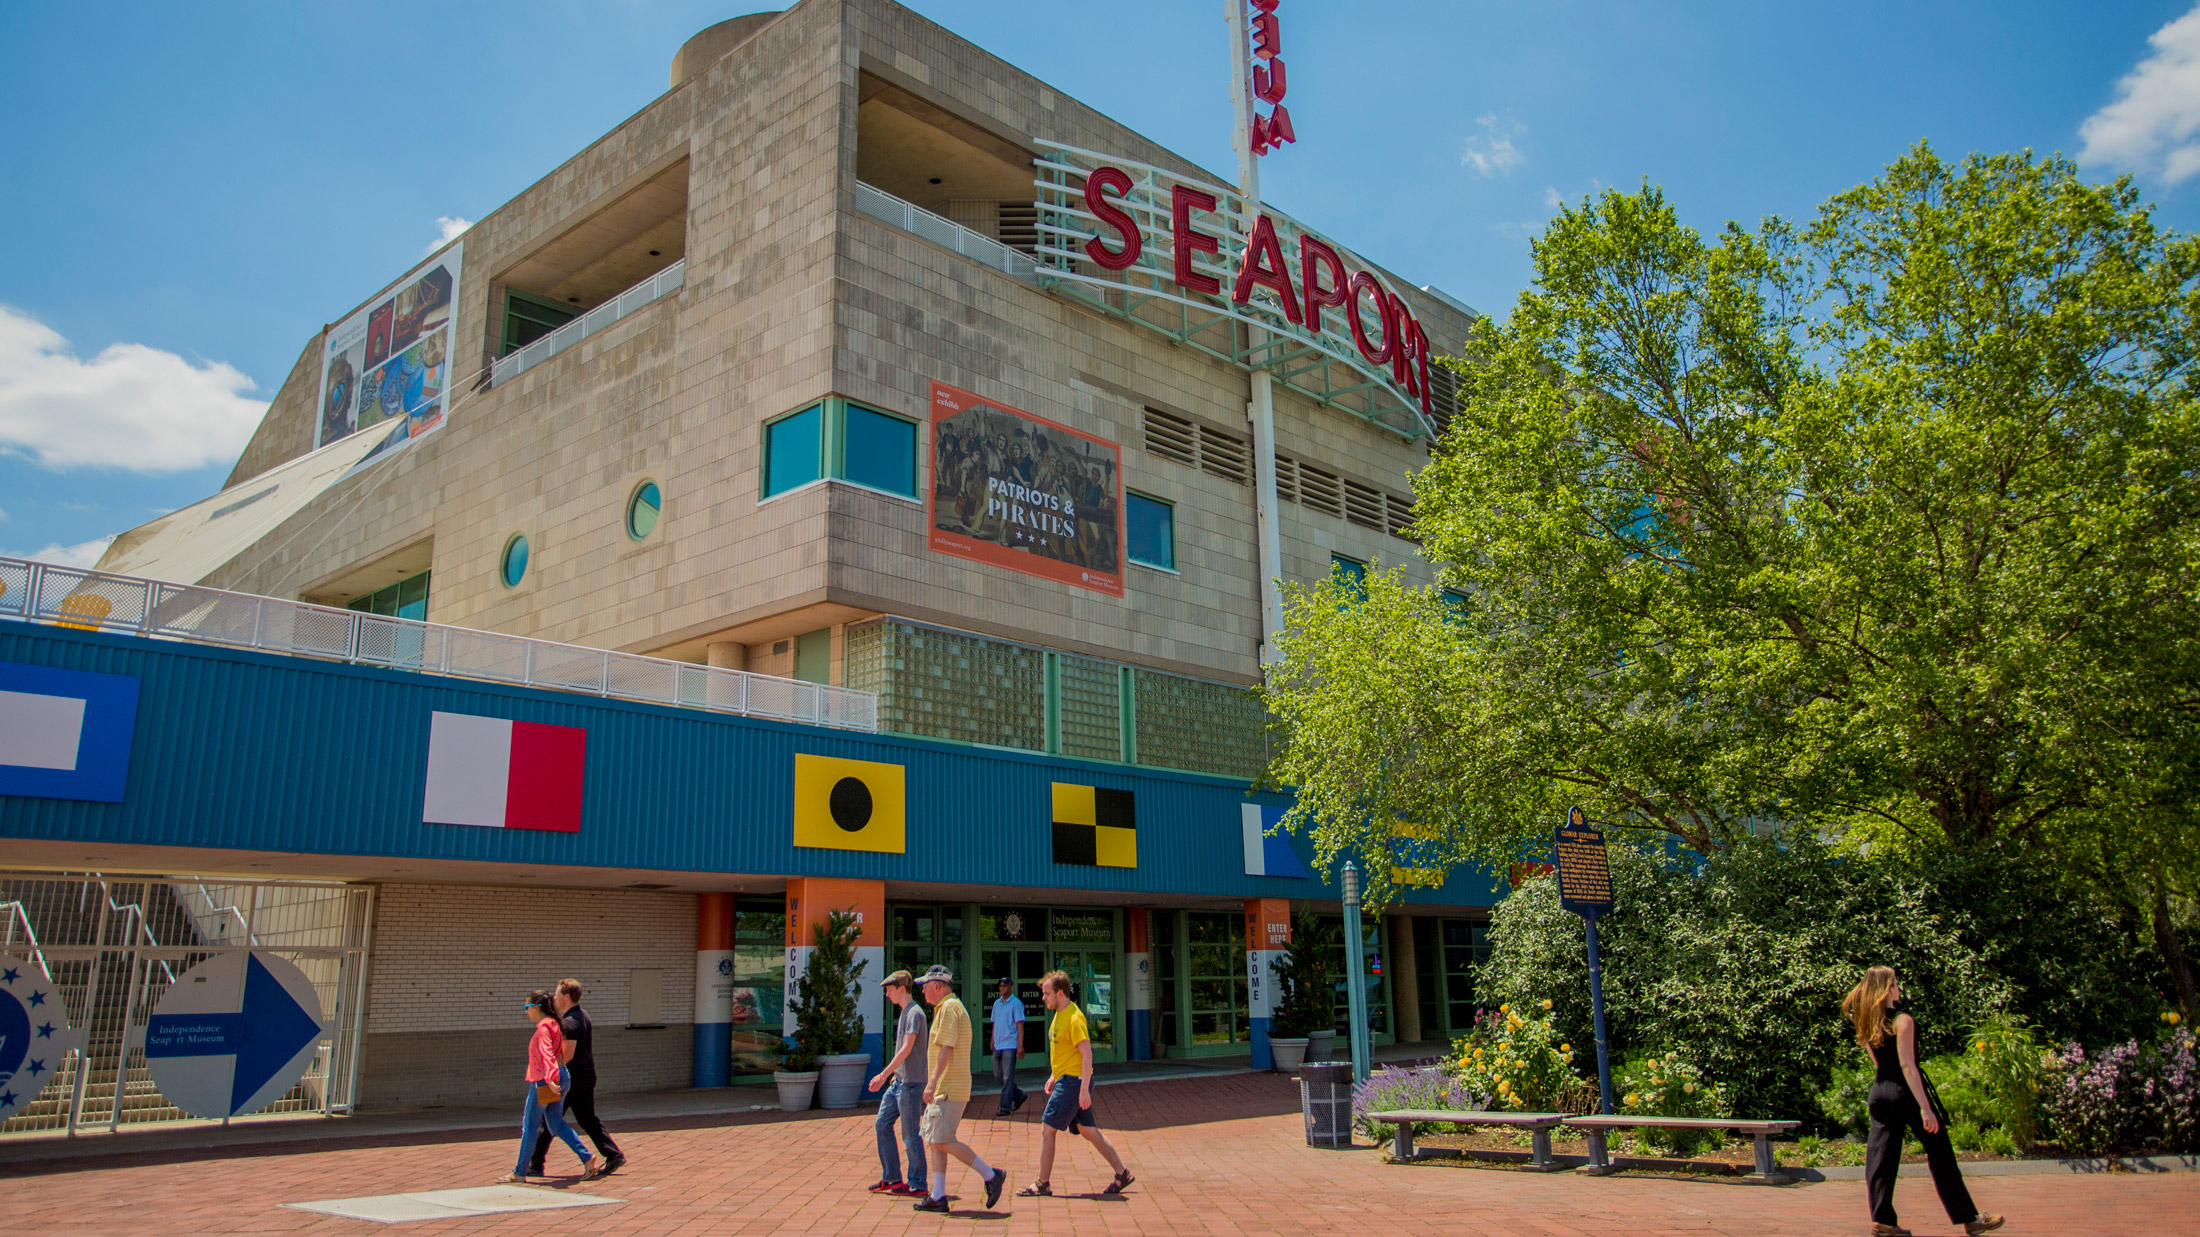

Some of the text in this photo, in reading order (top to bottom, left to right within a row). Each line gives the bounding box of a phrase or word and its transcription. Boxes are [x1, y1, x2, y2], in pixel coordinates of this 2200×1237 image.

[1085, 166, 1431, 415] SEAPORT
[937, 390, 951, 399] new
[936, 398, 959, 411] exhibit
[988, 476, 1075, 517] PATRIOTS &
[988, 497, 1075, 539] PIRATES
[1052, 914, 1102, 926] Independence
[1052, 927, 1111, 938] Seaport Museum
[1267, 923, 1288, 933] ENTER
[788, 897, 799, 1013] WELCOM
[1248, 913, 1260, 1001] WELCOME
[160, 1025, 221, 1035] Independence
[187, 1034, 225, 1043] Museum
